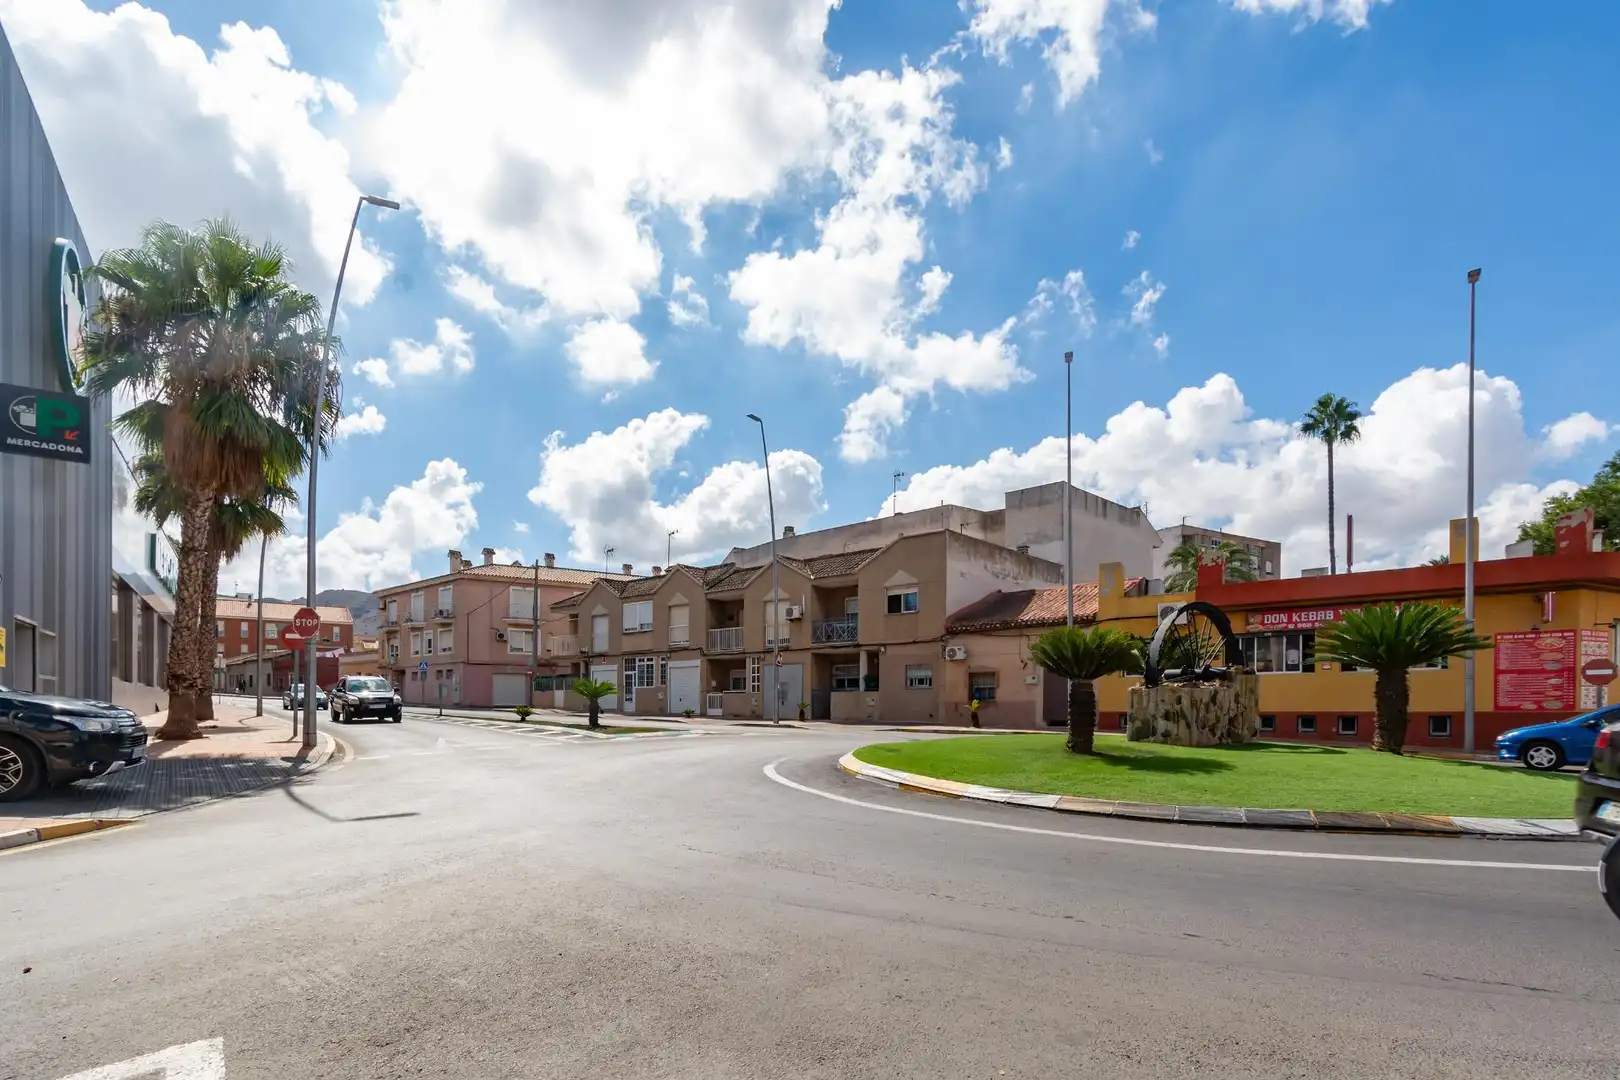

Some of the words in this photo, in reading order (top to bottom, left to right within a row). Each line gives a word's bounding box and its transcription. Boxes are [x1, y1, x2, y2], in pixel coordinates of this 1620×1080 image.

[6, 437, 83, 454] MERCADONA
[295, 618, 318, 627] STOP
[1264, 613, 1288, 624] DON
[1292, 610, 1334, 622] KEBAB
